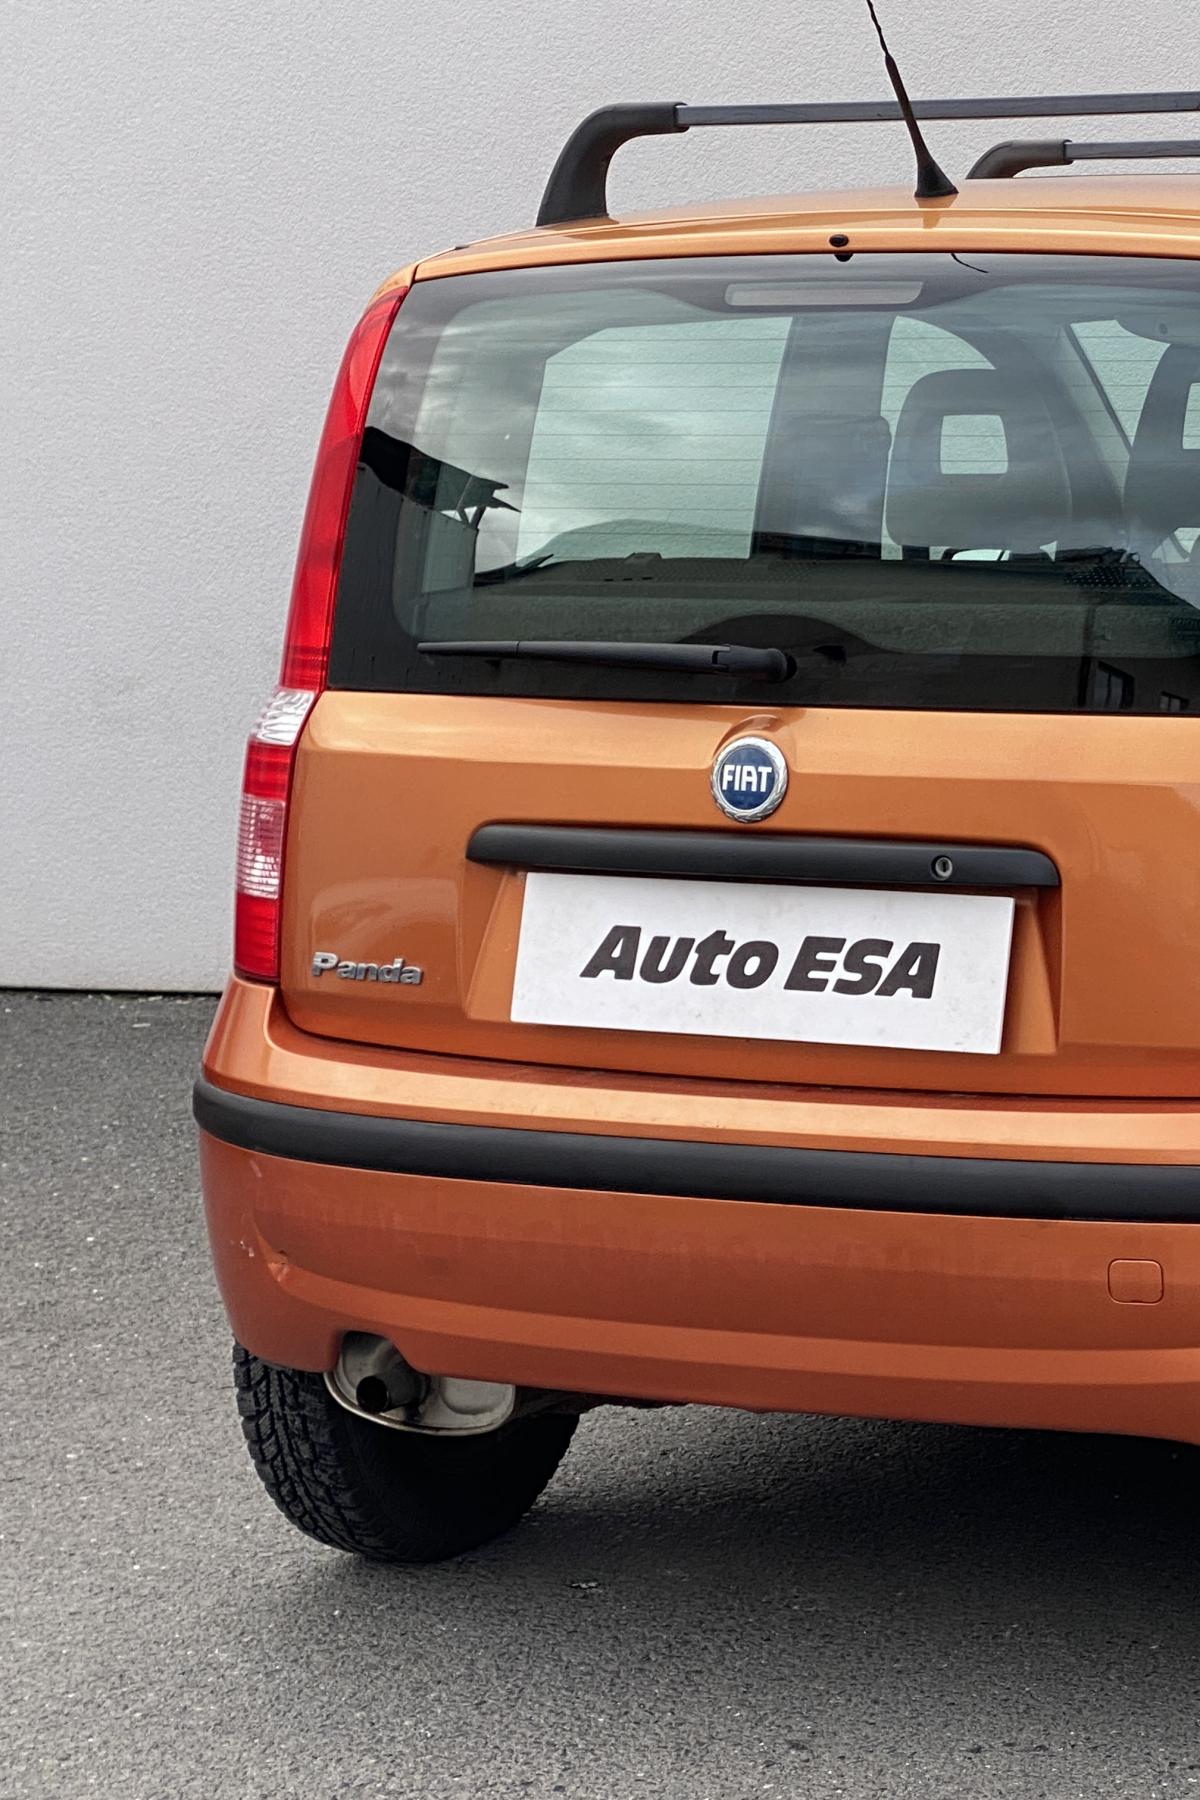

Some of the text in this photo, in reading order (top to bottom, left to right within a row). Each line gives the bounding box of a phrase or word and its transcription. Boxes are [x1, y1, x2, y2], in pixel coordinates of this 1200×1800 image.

[722, 764, 772, 792] FIAT
[312, 951, 423, 985] Panda
[579, 924, 941, 999] Auto ESA
